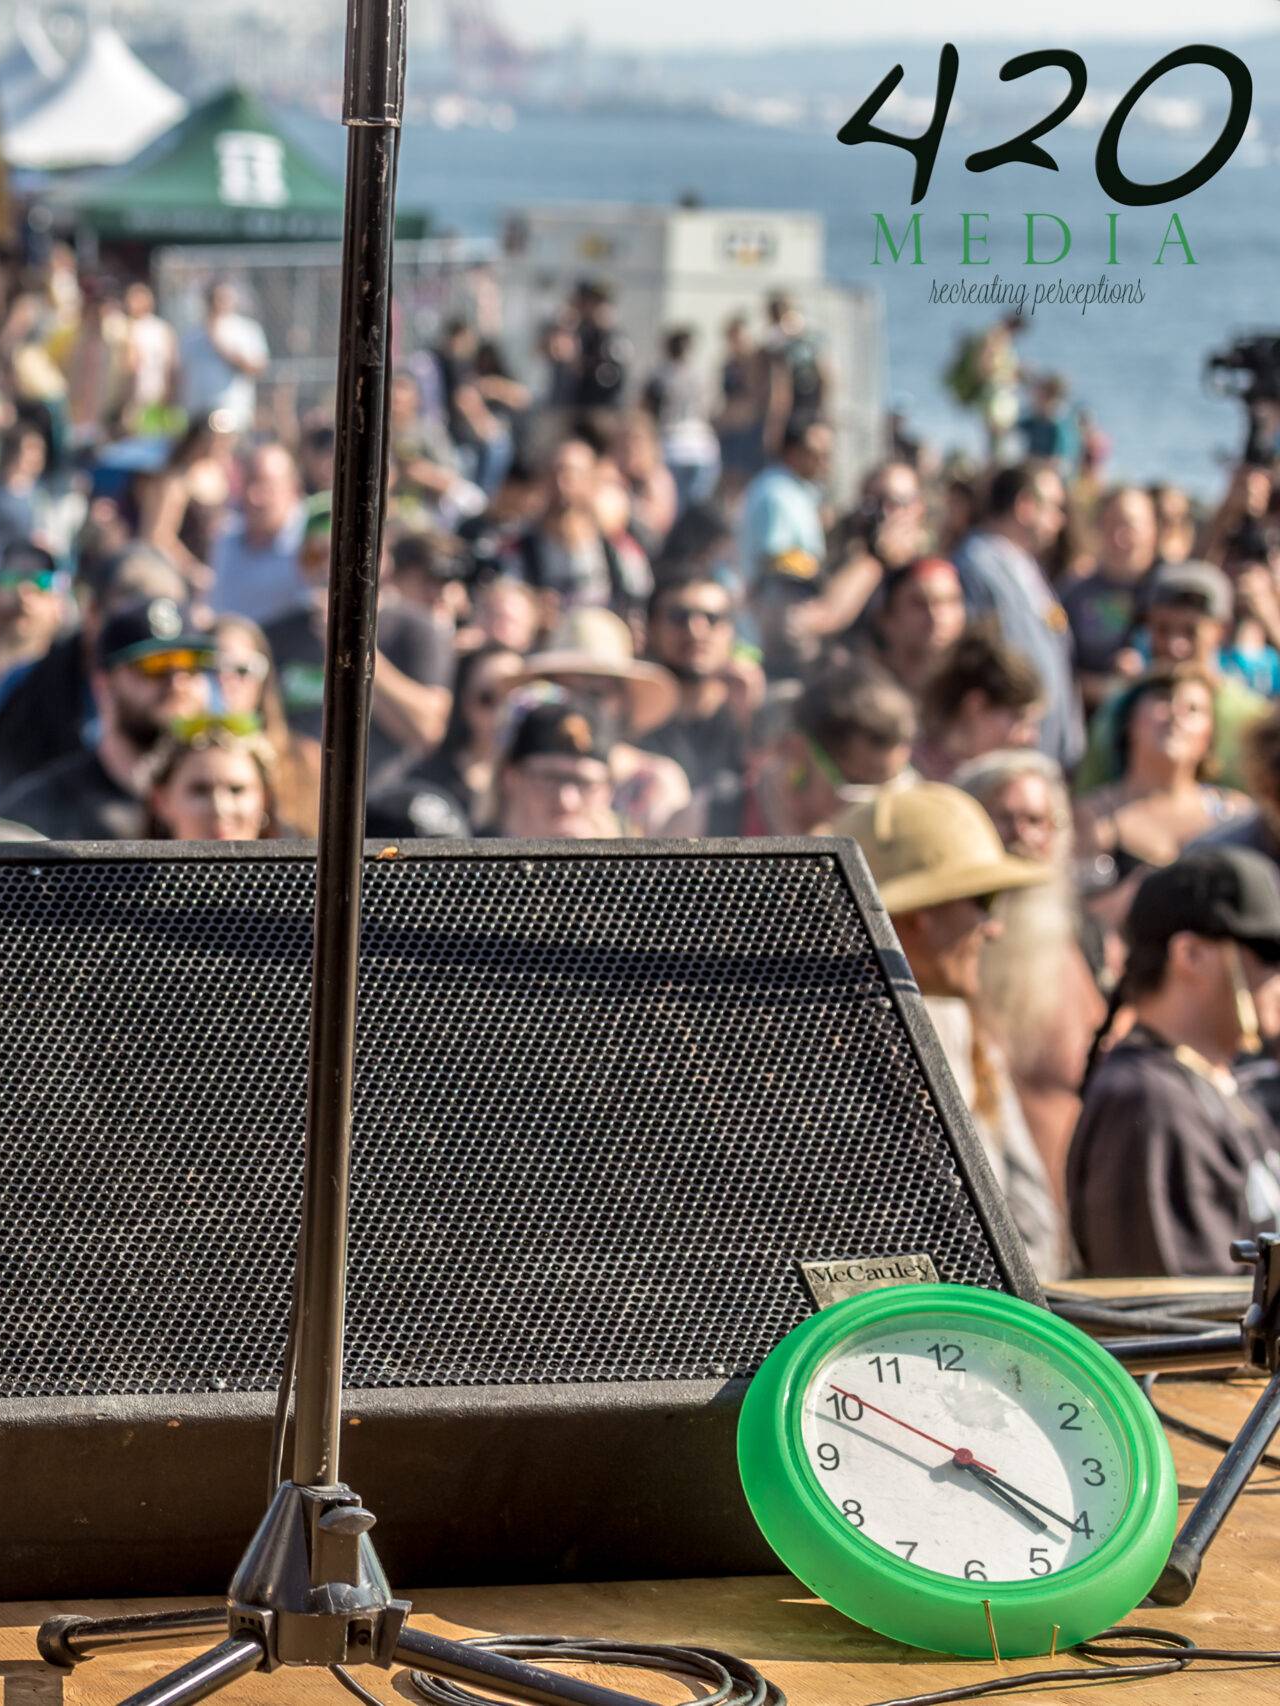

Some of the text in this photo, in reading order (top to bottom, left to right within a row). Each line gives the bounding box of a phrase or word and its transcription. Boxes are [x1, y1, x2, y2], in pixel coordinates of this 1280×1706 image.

[810, 1262, 929, 1284] McCauley
[868, 1356, 901, 1384] 11
[927, 1343, 967, 1372] 12
[826, 1392, 864, 1422] 10
[1057, 1402, 1083, 1431] 2
[817, 1443, 840, 1471] 9
[1082, 1457, 1106, 1487] 3
[842, 1500, 865, 1528] 8
[1073, 1510, 1095, 1540] 4
[895, 1541, 919, 1562] 7
[1029, 1547, 1053, 1576] 5
[964, 1559, 988, 1581] 6
